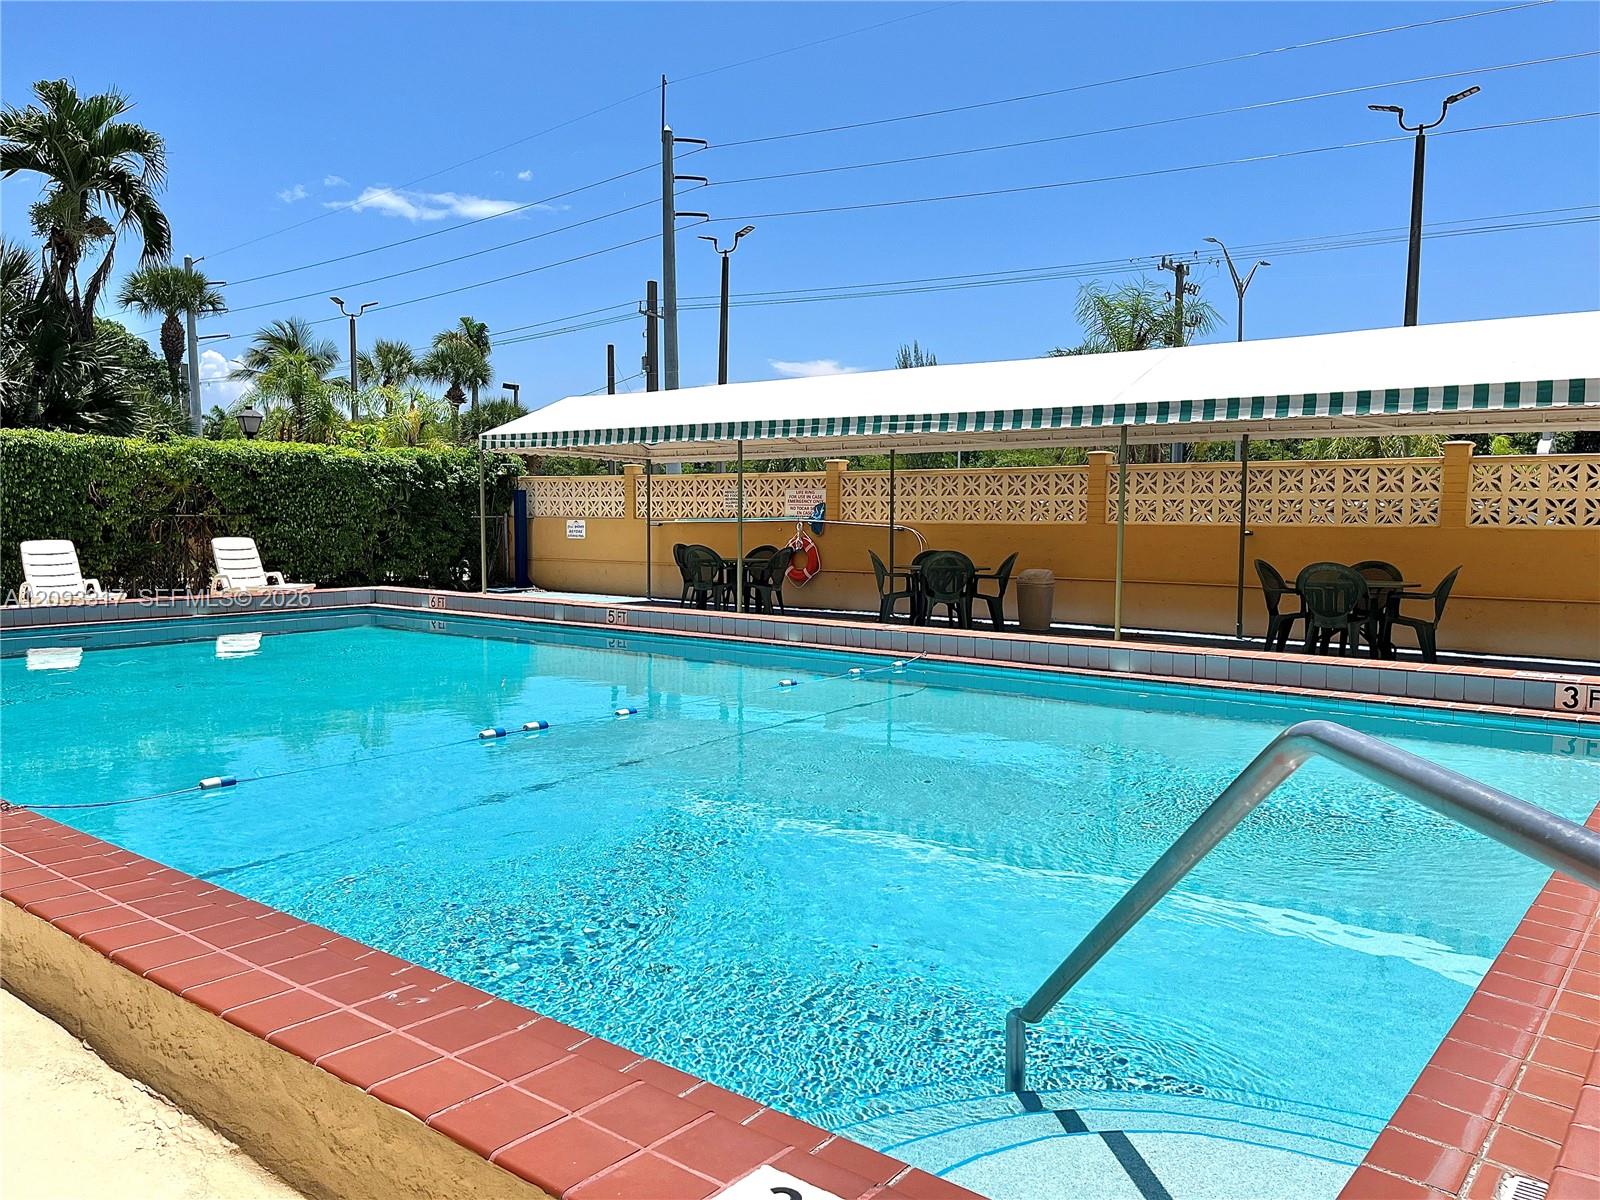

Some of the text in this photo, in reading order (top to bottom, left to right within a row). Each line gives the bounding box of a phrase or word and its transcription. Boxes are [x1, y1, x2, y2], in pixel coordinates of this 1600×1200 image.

[430, 596, 445, 608] 6 FT
[608, 609, 627, 624] 5 FT
[1562, 686, 1579, 709] 3
